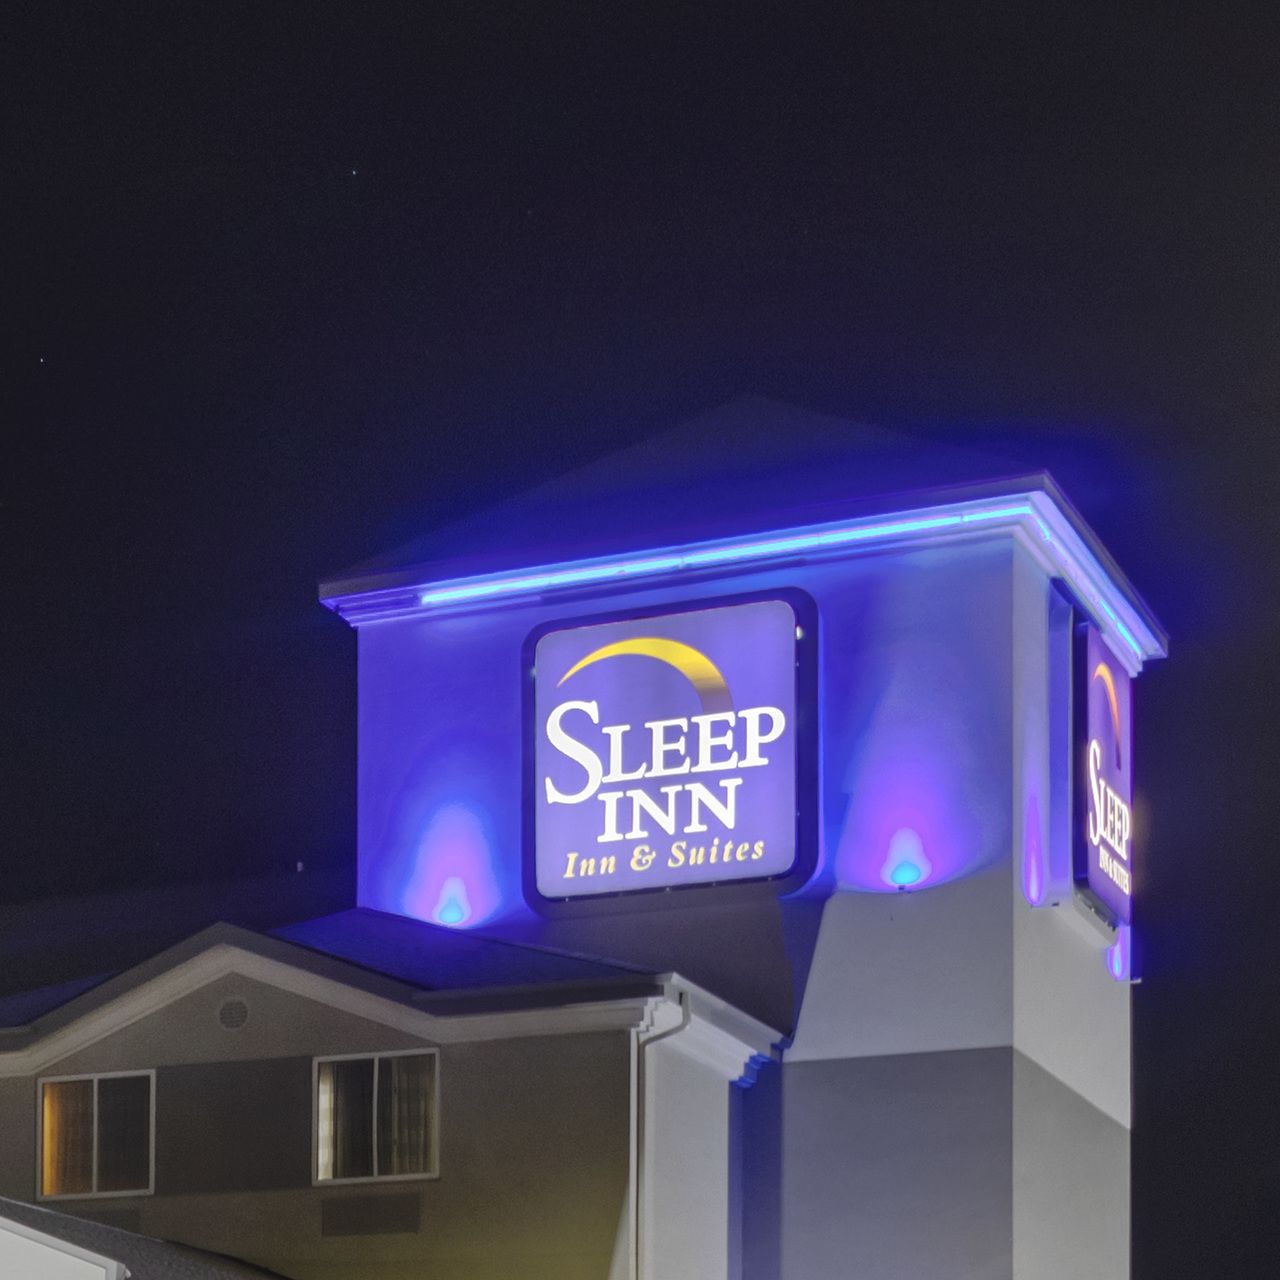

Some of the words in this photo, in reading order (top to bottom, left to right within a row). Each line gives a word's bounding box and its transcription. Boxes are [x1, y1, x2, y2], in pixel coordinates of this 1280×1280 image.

[545, 700, 786, 804] SLEEP
[597, 778, 743, 843] INN
[1090, 739, 1130, 861] SLEEP
[562, 852, 617, 879] Inn
[630, 844, 657, 872] &
[667, 837, 765, 868] Suites
